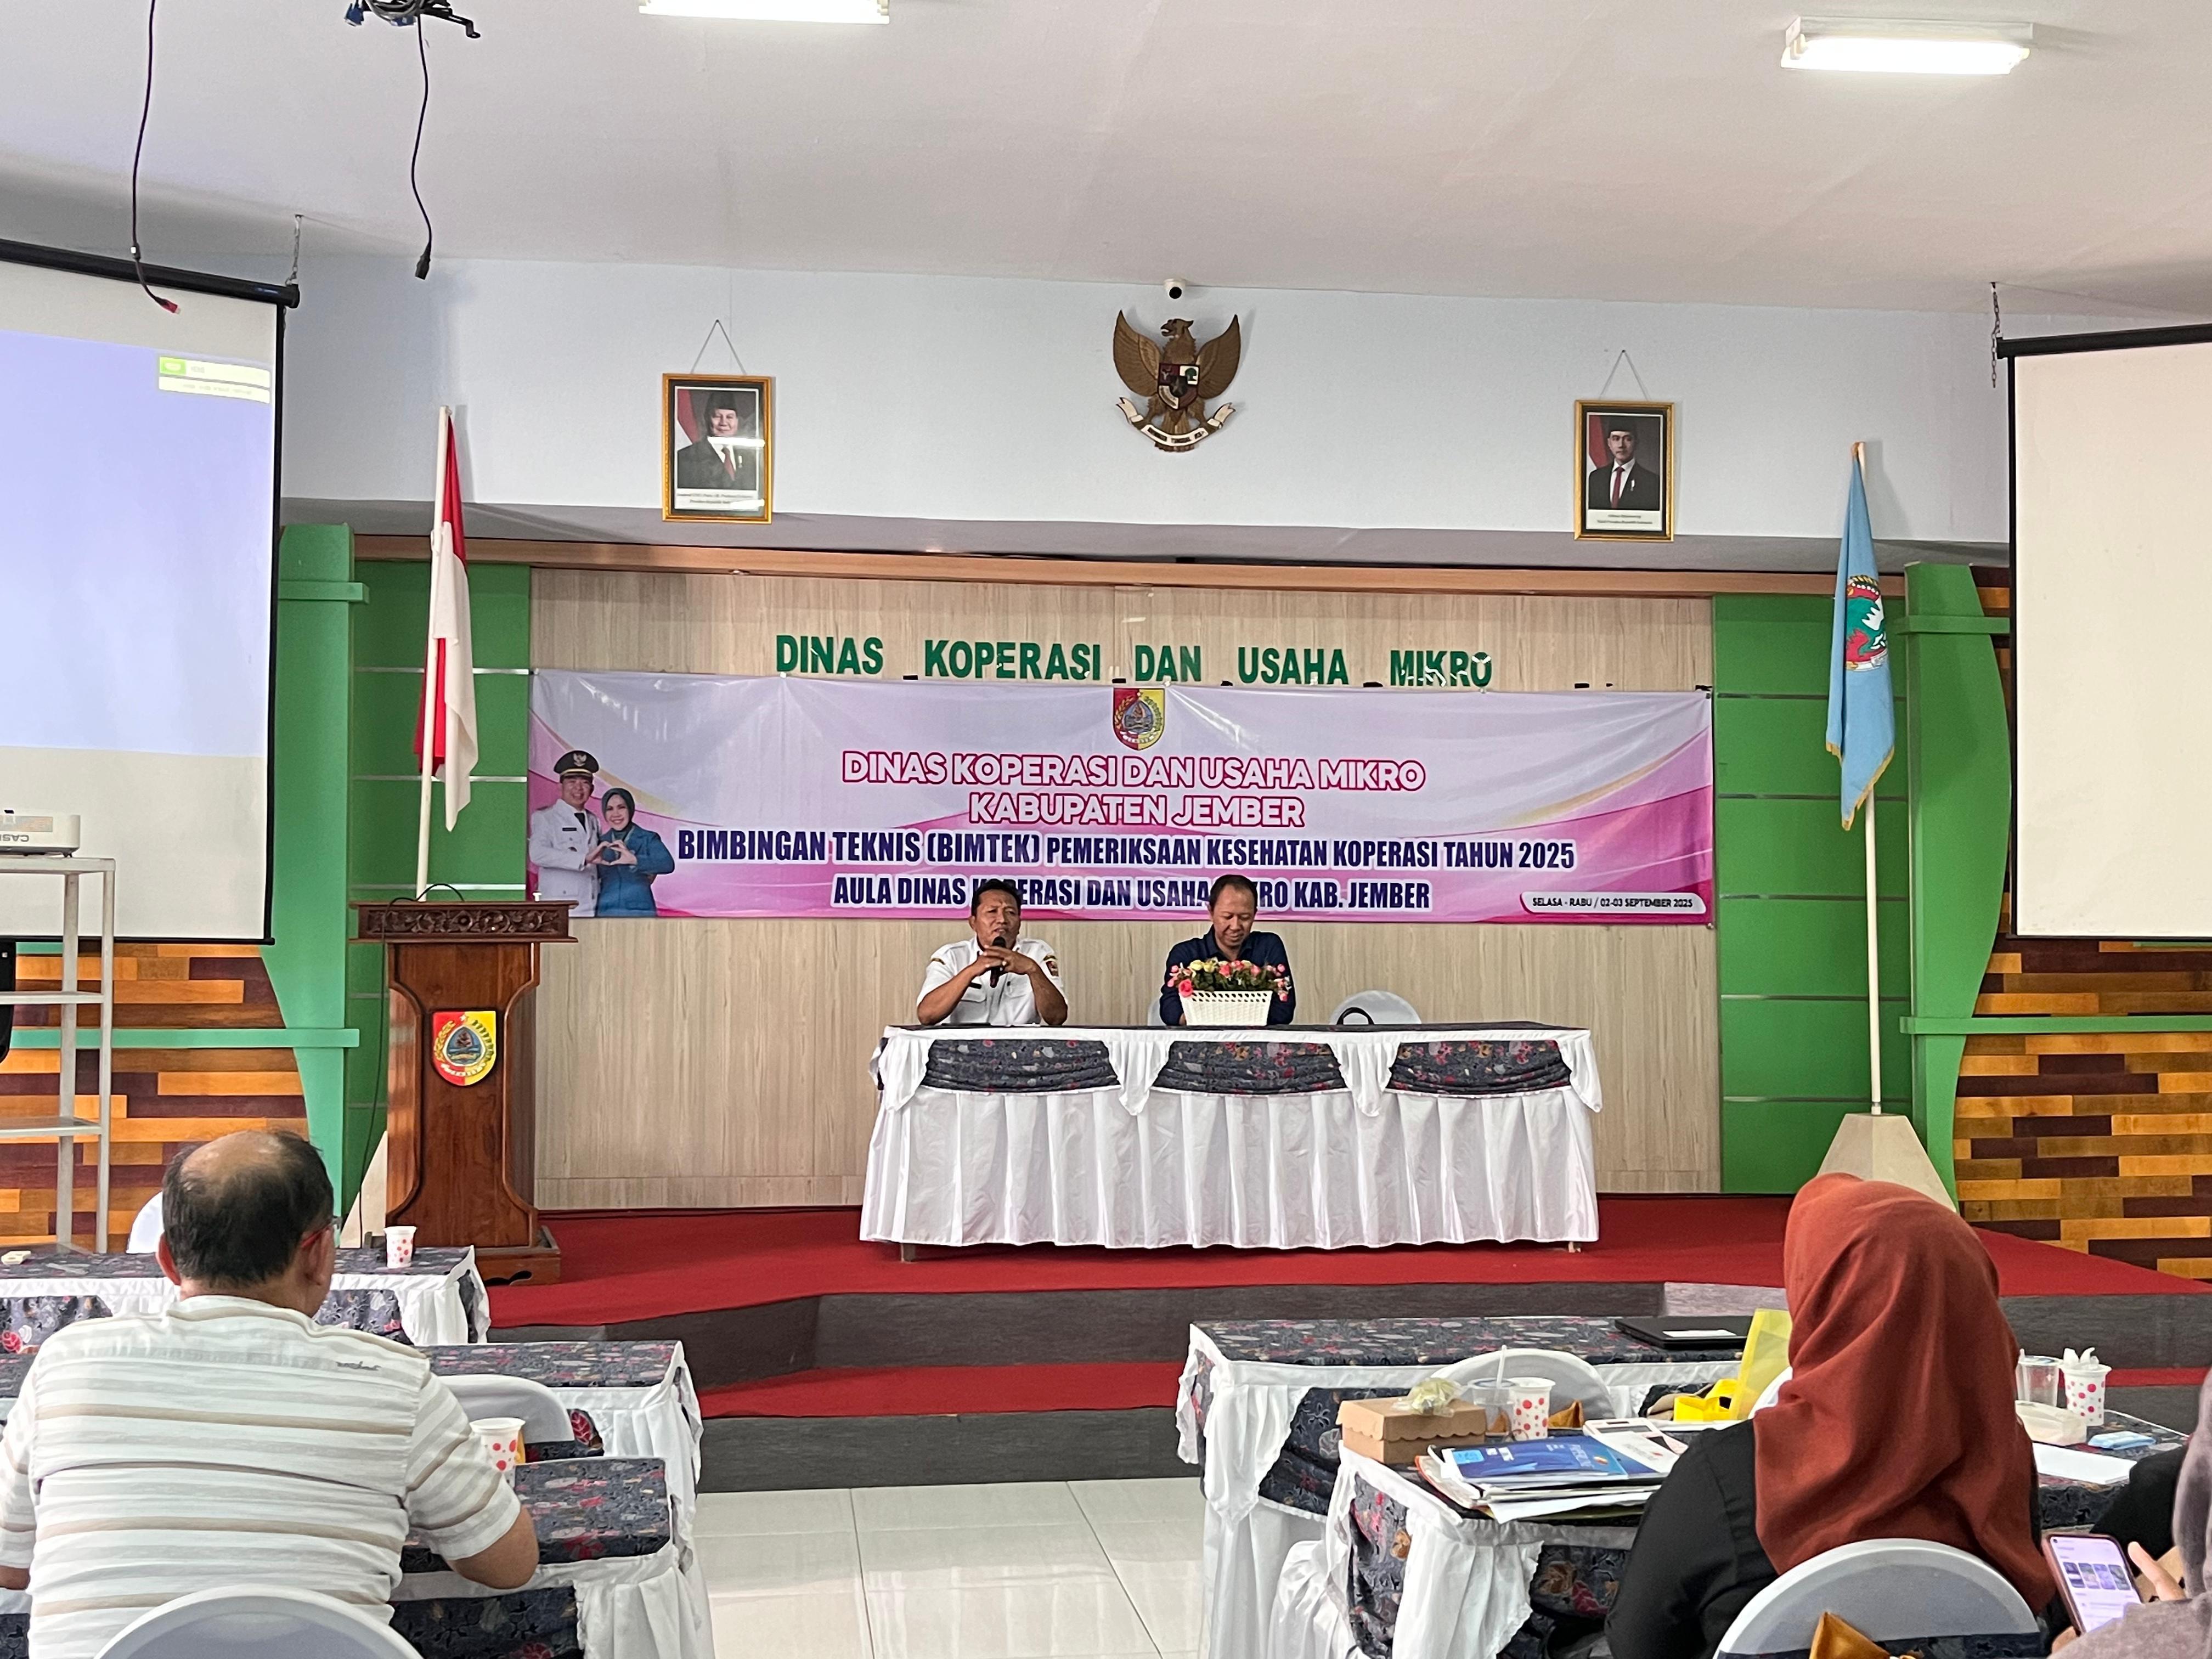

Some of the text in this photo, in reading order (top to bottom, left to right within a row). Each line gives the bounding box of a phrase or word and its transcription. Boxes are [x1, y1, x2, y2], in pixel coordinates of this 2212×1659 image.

[776, 635, 1492, 687] DINAS KOPERASI DAN USAHA MIKRO
[843, 751, 1426, 792] DINAS KOPERASI DAN USAHA MIKRO
[969, 792, 1305, 827] KABUPATEN JEMBER
[679, 830, 1574, 868] BIMBINGAN TEKNIS (BIMTEK) PEMERIKSAAN KESEHATAN KOPERASI TAHUN 2025
[834, 877, 891, 904] AULA
[898, 877, 966, 905] DINAS
[972, 878, 1080, 905] ERASI
[1087, 880, 1131, 906] DAN
[1137, 880, 1211, 907] USAHA
[1294, 882, 1343, 908] KAB.
[1348, 882, 1429, 909] JEMBER
[1533, 898, 1562, 906] SELASA
[1625, 898, 1671, 907] SEPTEMBER
[1673, 899, 1693, 907] 2025
